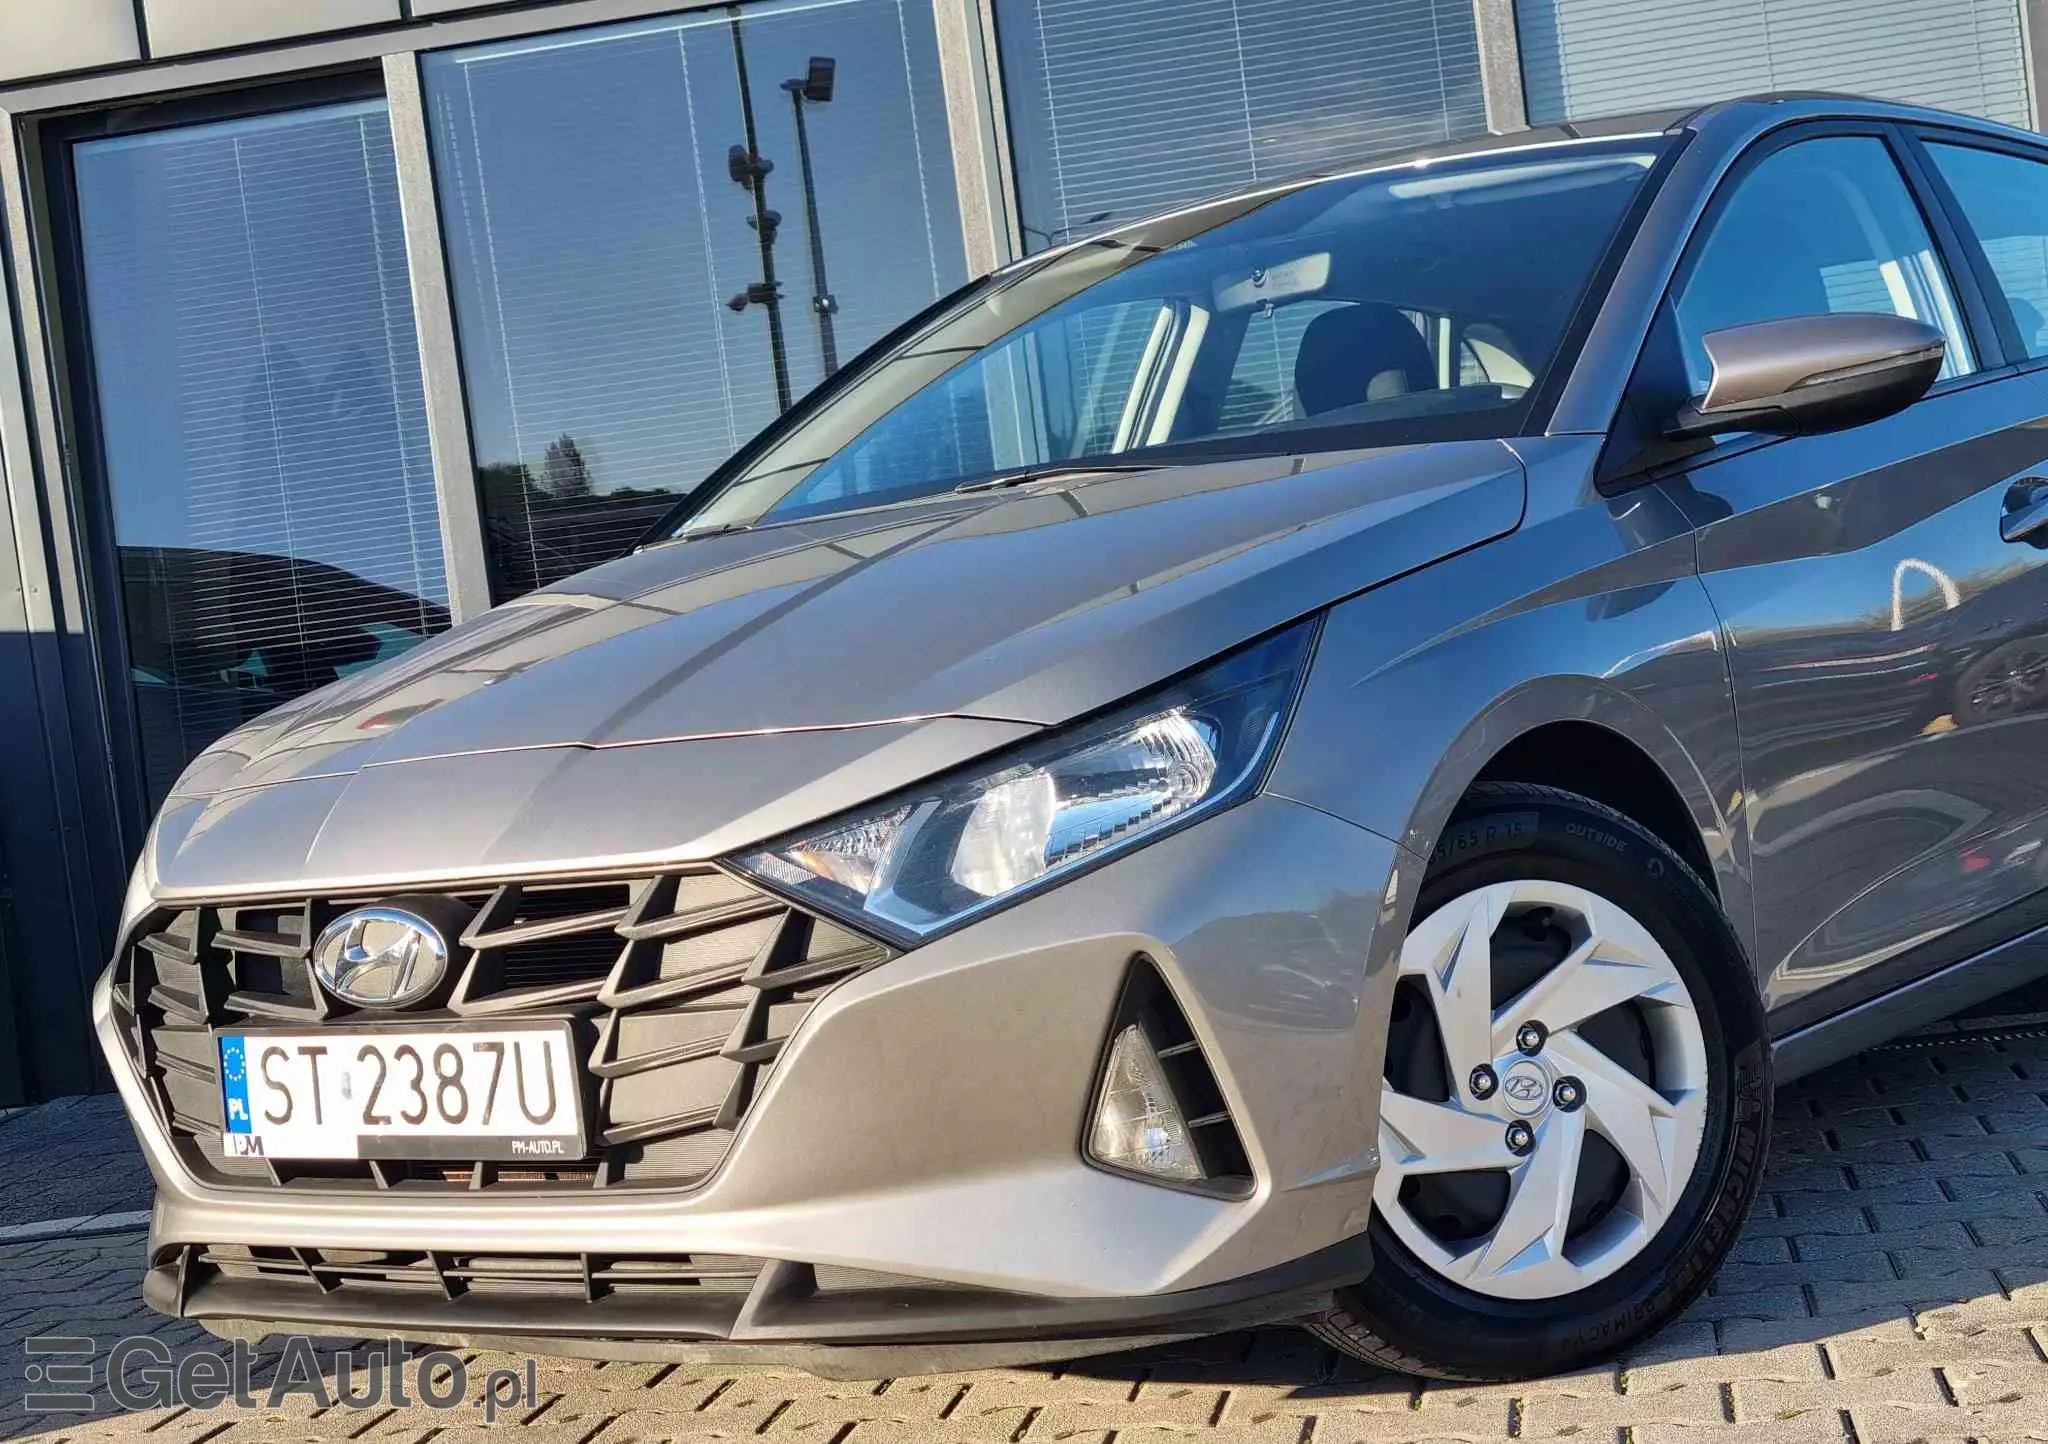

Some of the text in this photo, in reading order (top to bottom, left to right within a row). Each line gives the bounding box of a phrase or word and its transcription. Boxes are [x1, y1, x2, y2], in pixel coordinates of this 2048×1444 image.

[1565, 822, 1629, 853] OUTSIDE
[260, 1039, 558, 1127] ST 2387U
[227, 1097, 249, 1121] PL
[511, 1139, 566, 1155] PM-AUTO.PL
